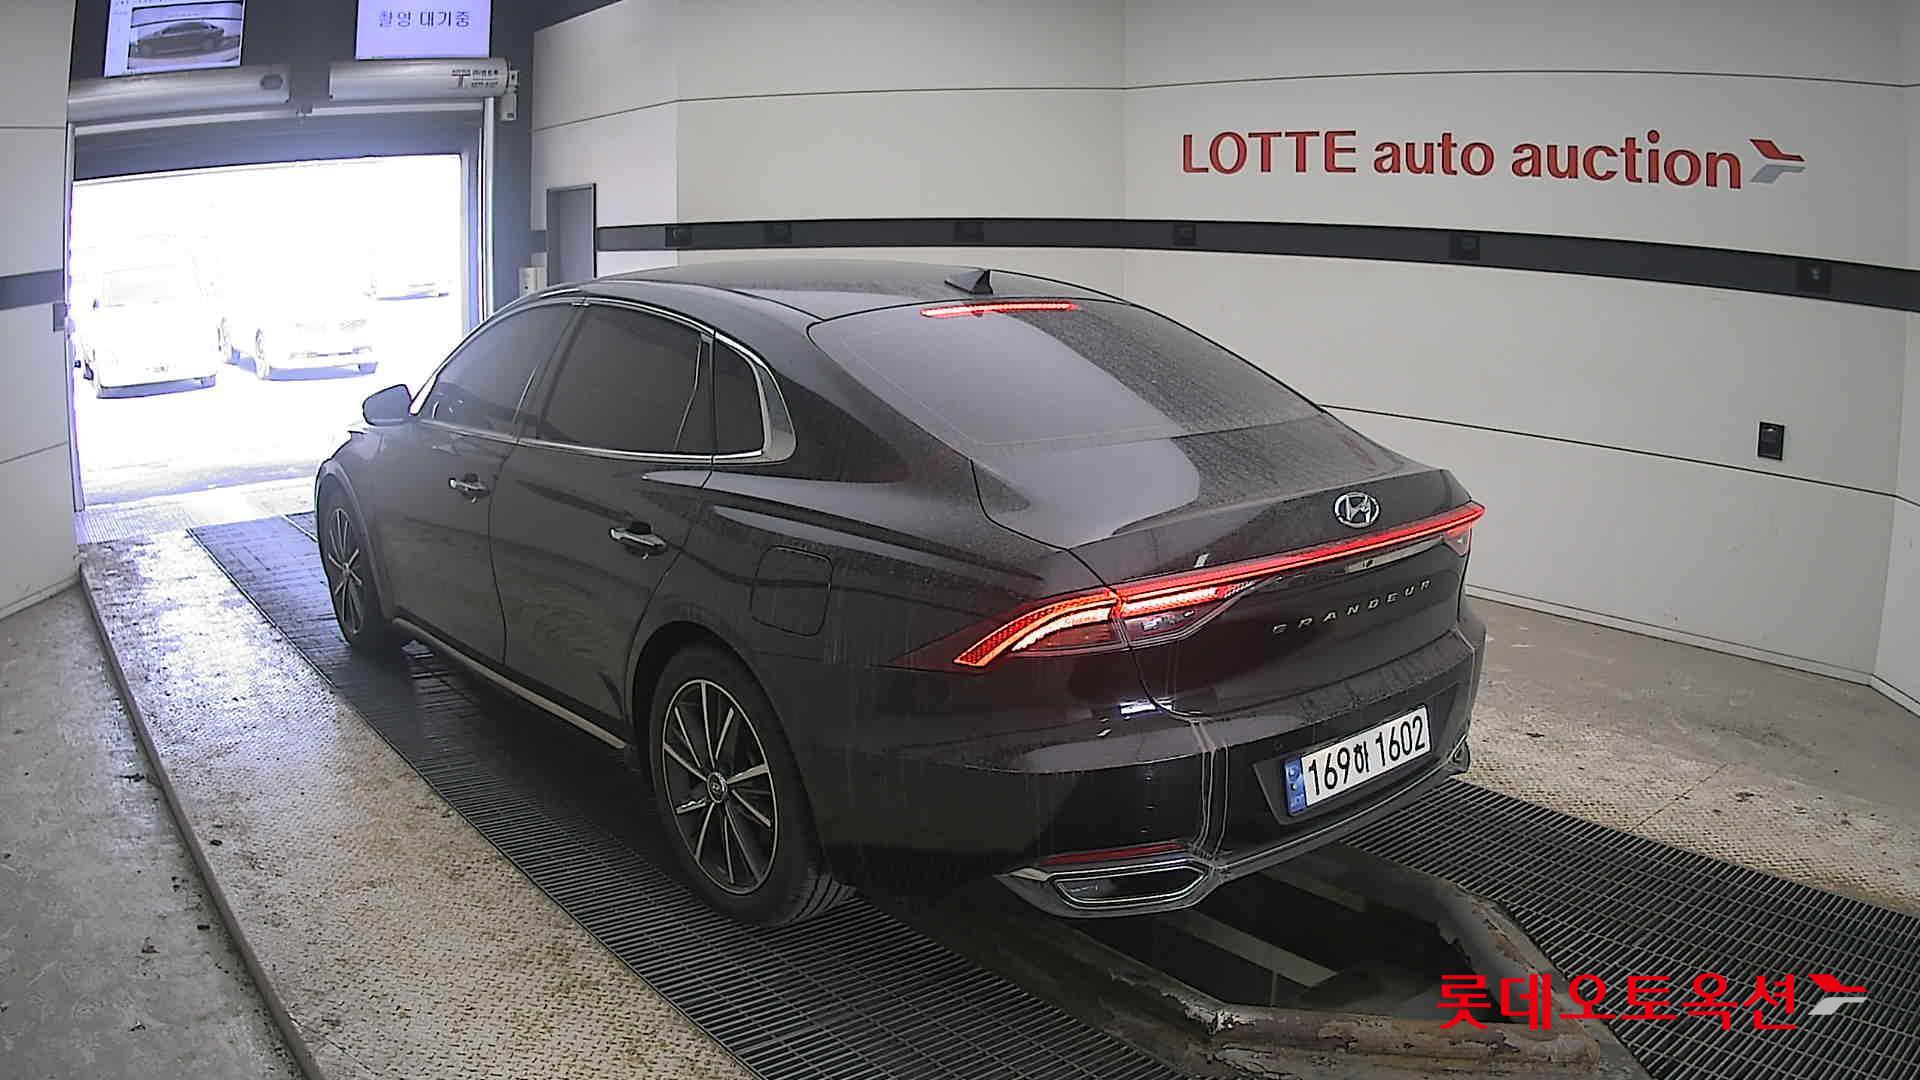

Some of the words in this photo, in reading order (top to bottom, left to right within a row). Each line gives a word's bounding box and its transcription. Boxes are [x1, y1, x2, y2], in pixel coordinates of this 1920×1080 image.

[419, 10, 471, 28] 대기중
[1182, 130, 1357, 174] LOTTE
[1373, 132, 1496, 177] auto
[1511, 129, 1743, 189] auction
[1272, 580, 1433, 634] GRANDEUR
[1308, 741, 1370, 796] 169하
[1376, 715, 1426, 767] 1602
